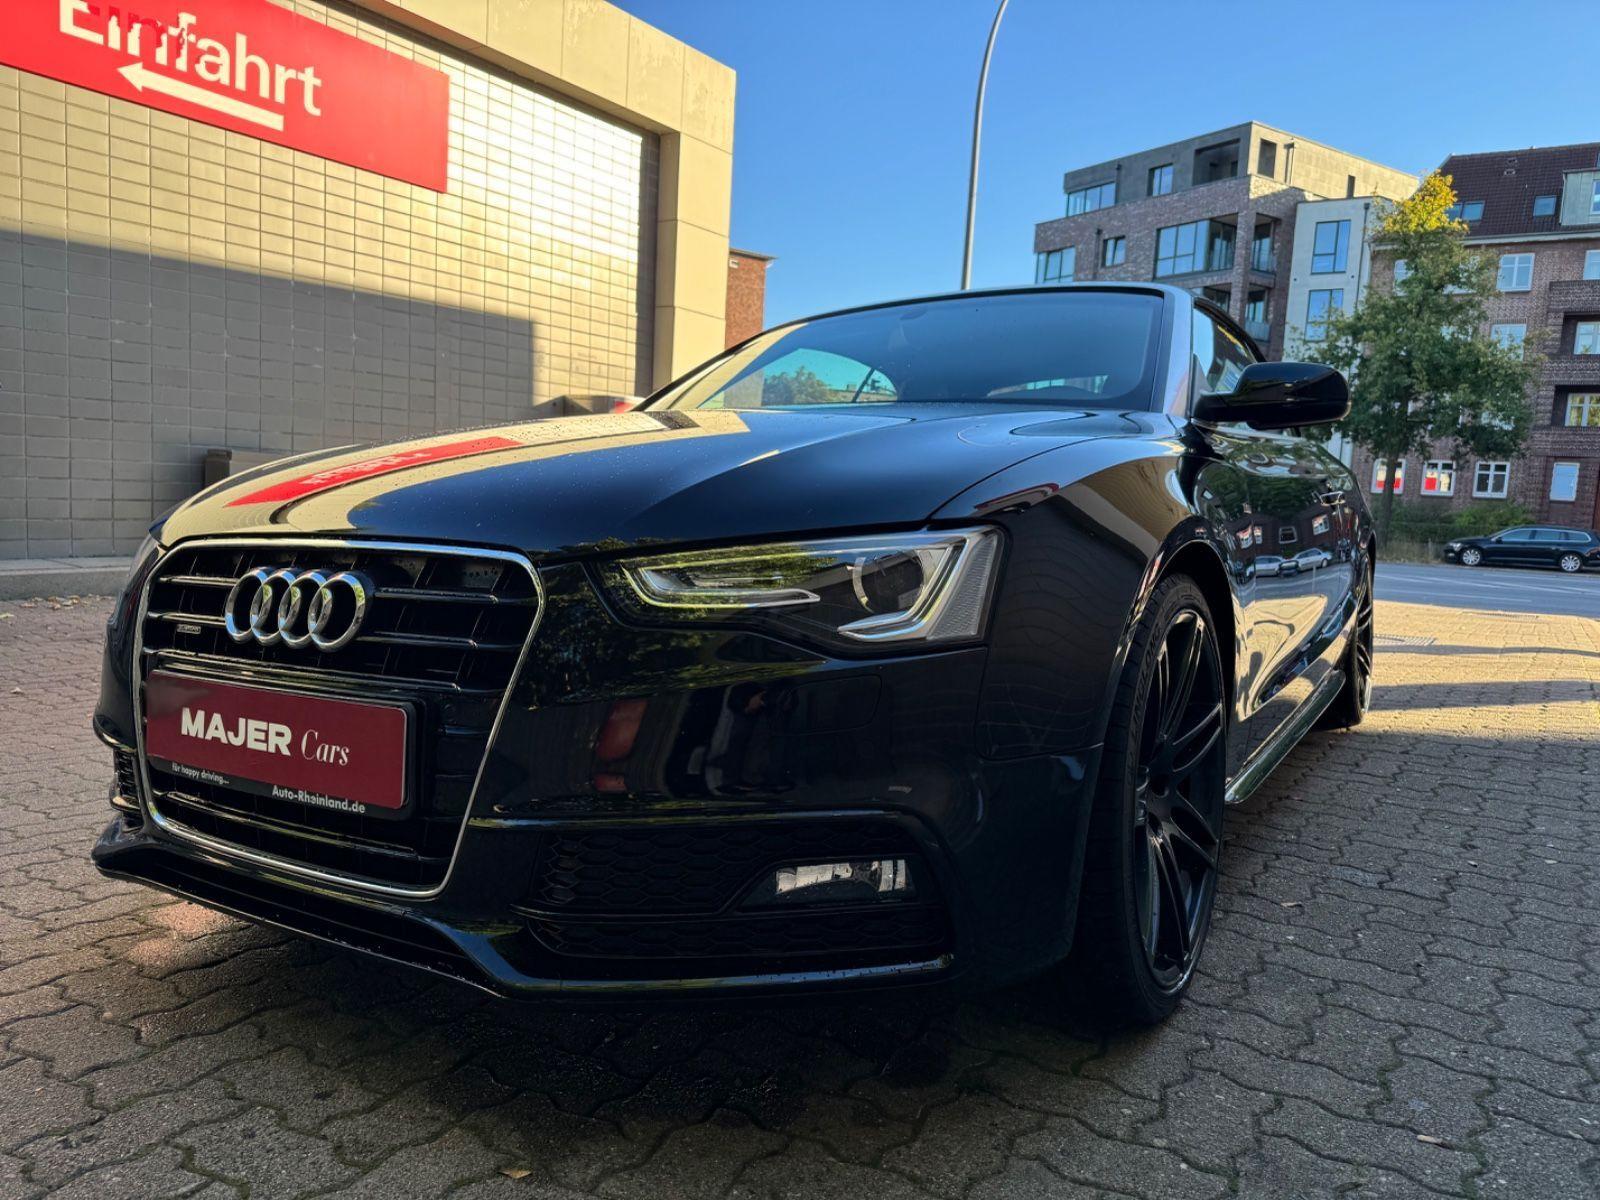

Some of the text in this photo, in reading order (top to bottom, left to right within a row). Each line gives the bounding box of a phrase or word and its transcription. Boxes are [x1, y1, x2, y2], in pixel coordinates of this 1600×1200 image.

[181, 706, 350, 766] MAJER Cars
[181, 764, 201, 780] happy
[272, 784, 366, 813] Auto-Rheinland.de
